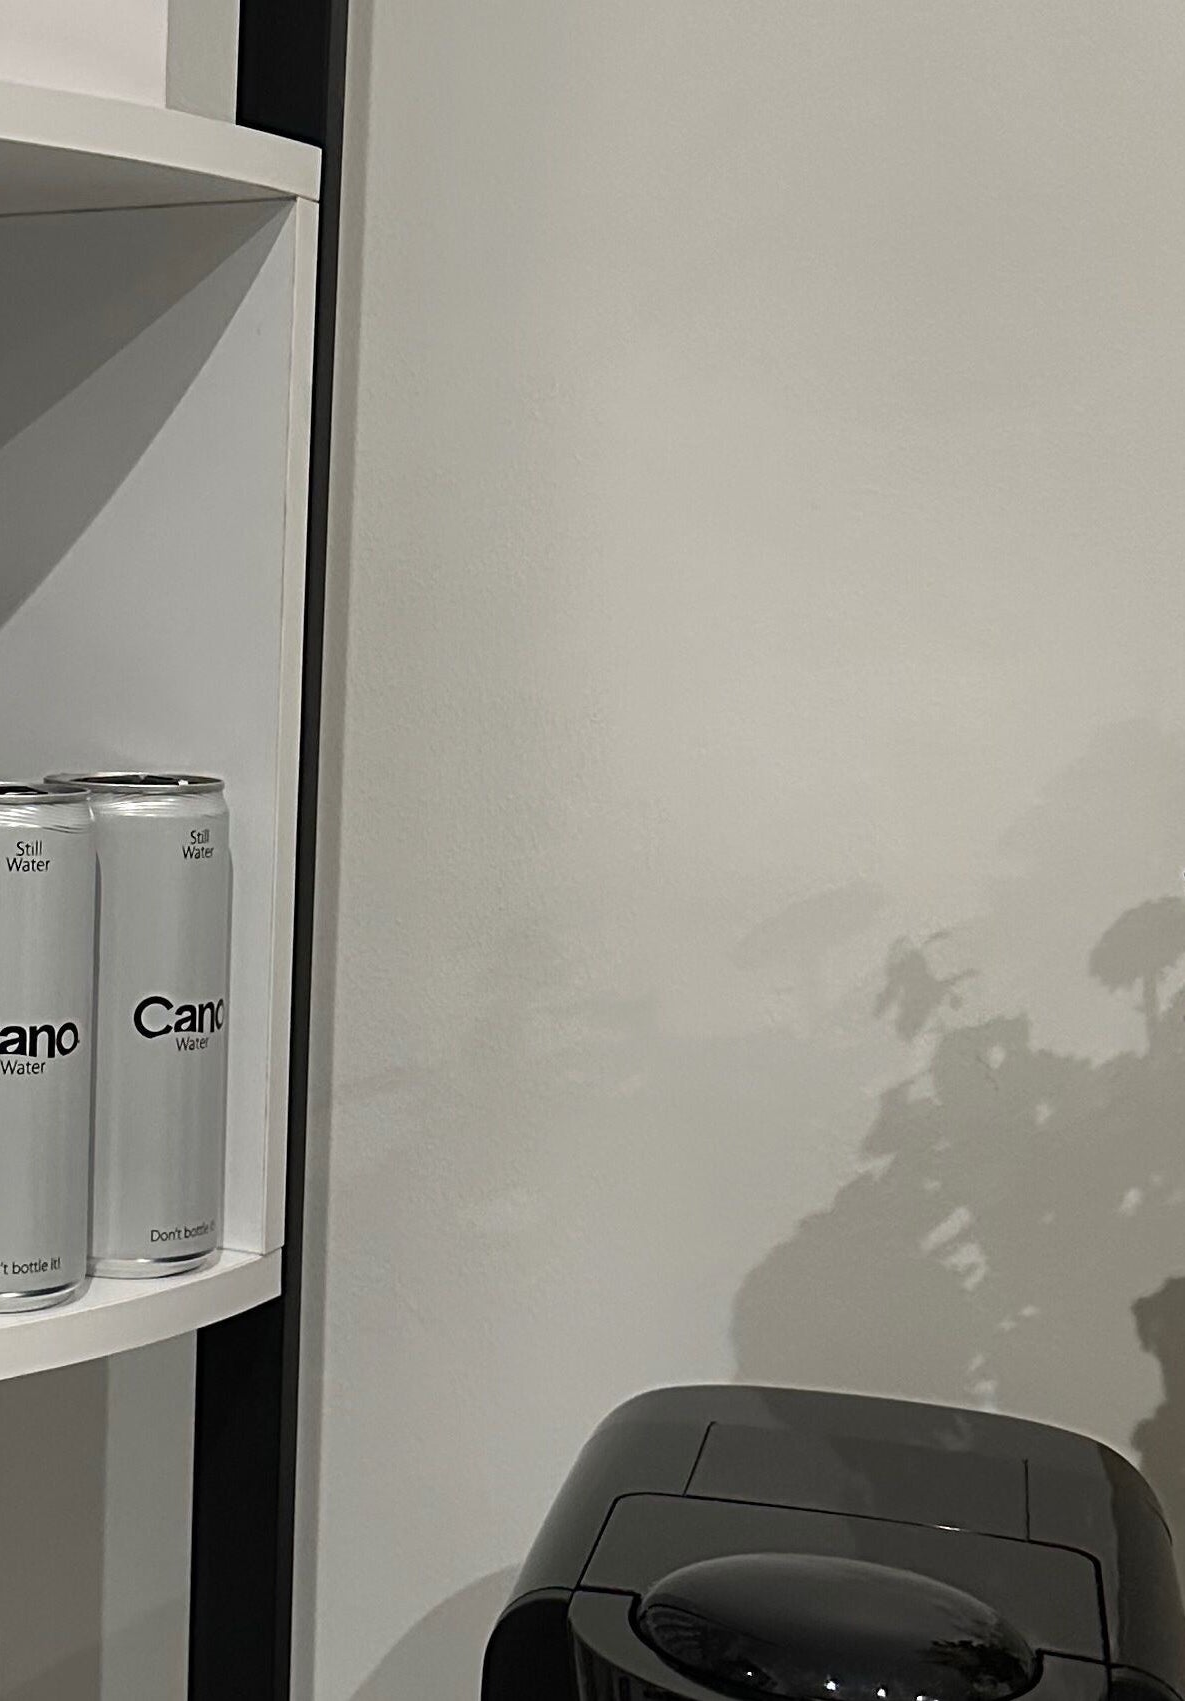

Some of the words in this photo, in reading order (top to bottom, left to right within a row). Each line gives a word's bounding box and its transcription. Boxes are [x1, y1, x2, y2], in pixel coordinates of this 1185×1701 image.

[15, 840, 43, 856] Still
[182, 846, 215, 860] Water
[6, 857, 51, 873] Water
[176, 1036, 210, 1052] Water
[0, 1059, 46, 1075] Water
[12, 1258, 49, 1275] bottle
[51, 1256, 61, 1271] it!
